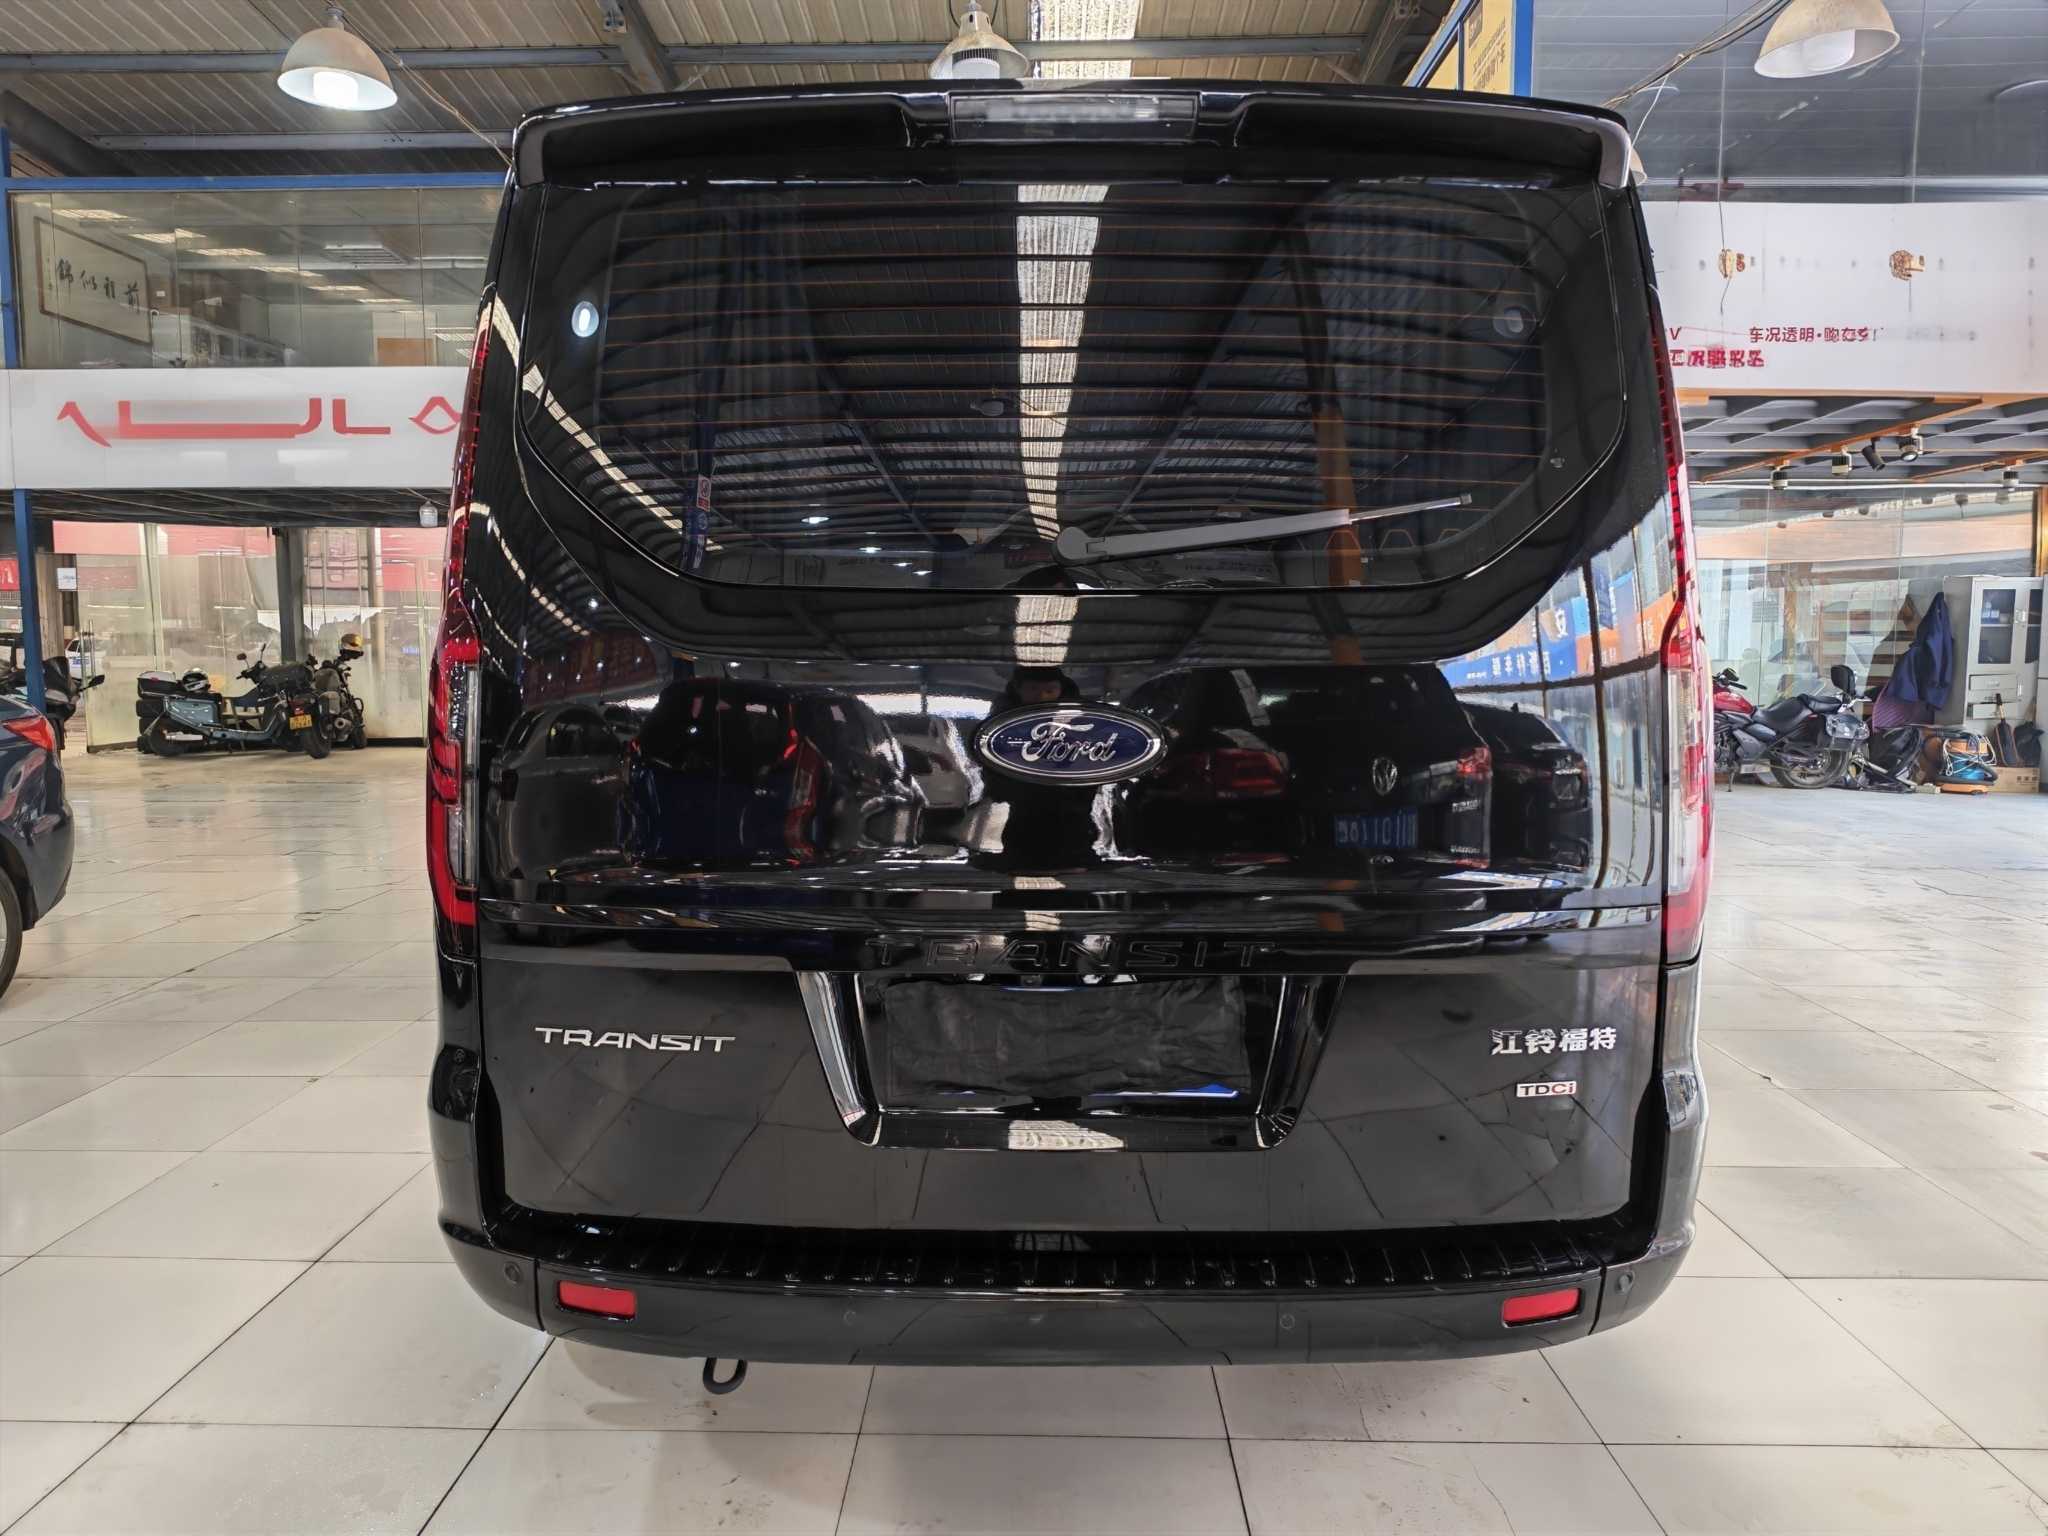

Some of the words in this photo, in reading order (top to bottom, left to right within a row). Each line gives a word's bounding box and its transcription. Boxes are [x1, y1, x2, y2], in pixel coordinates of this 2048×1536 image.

[1018, 721, 1119, 762] Ford
[864, 937, 1277, 967] TRANSIT
[535, 1027, 736, 1052] TRANSIT
[1491, 1028, 1617, 1055] 江铃福特
